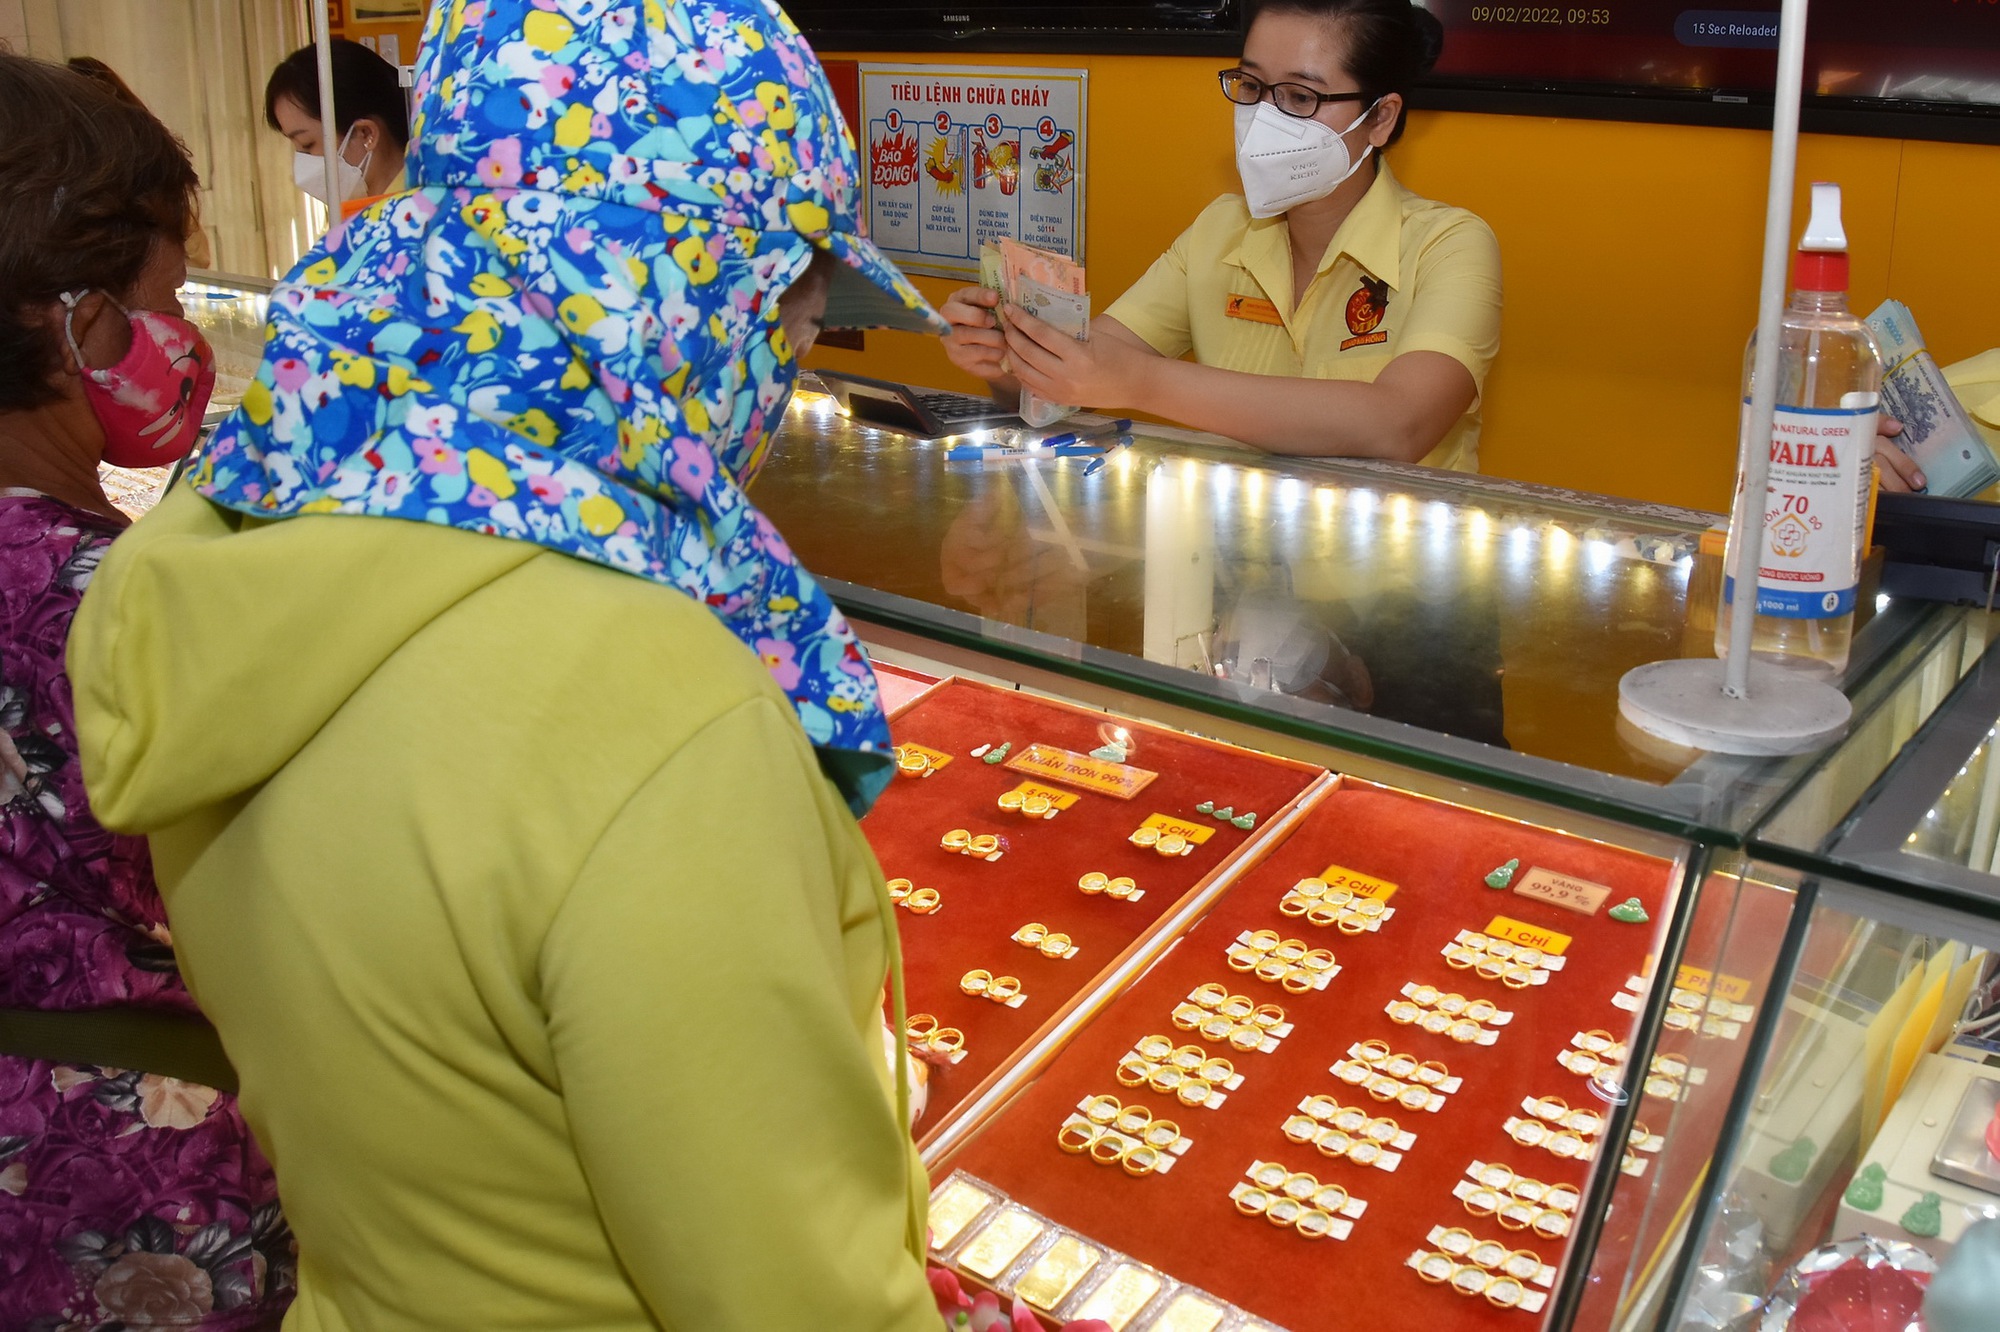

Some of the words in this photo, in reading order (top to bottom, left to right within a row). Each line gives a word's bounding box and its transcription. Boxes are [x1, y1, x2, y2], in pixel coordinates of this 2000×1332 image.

[1471, 7, 1563, 25] 09/02/2022,
[1567, 9, 1610, 24] 09:53
[1693, 23, 1705, 34] 15
[1708, 23, 1727, 35] Sec
[1729, 24, 1778, 37] Reloaded
[891, 81, 921, 101] TIÊU
[926, 82, 961, 106] LỆNH
[967, 84, 1006, 105] CHỮA
[1011, 85, 1050, 107] CHÁY
[889, 113, 898, 128] 1
[937, 114, 948, 130] 2
[988, 117, 999, 134] 3
[1039, 120, 1053, 136] 4
[1292, 161, 1318, 171] VN95
[1780, 424, 1819, 436] NATURAL
[1822, 427, 1850, 436] GREEN
[1782, 494, 1809, 514] 70
[1026, 788, 1037, 796] 5
[1156, 822, 1167, 830] 3
[1335, 876, 1346, 884] 2
[1575, 895, 1589, 906] %
[1505, 927, 1513, 936] 1
